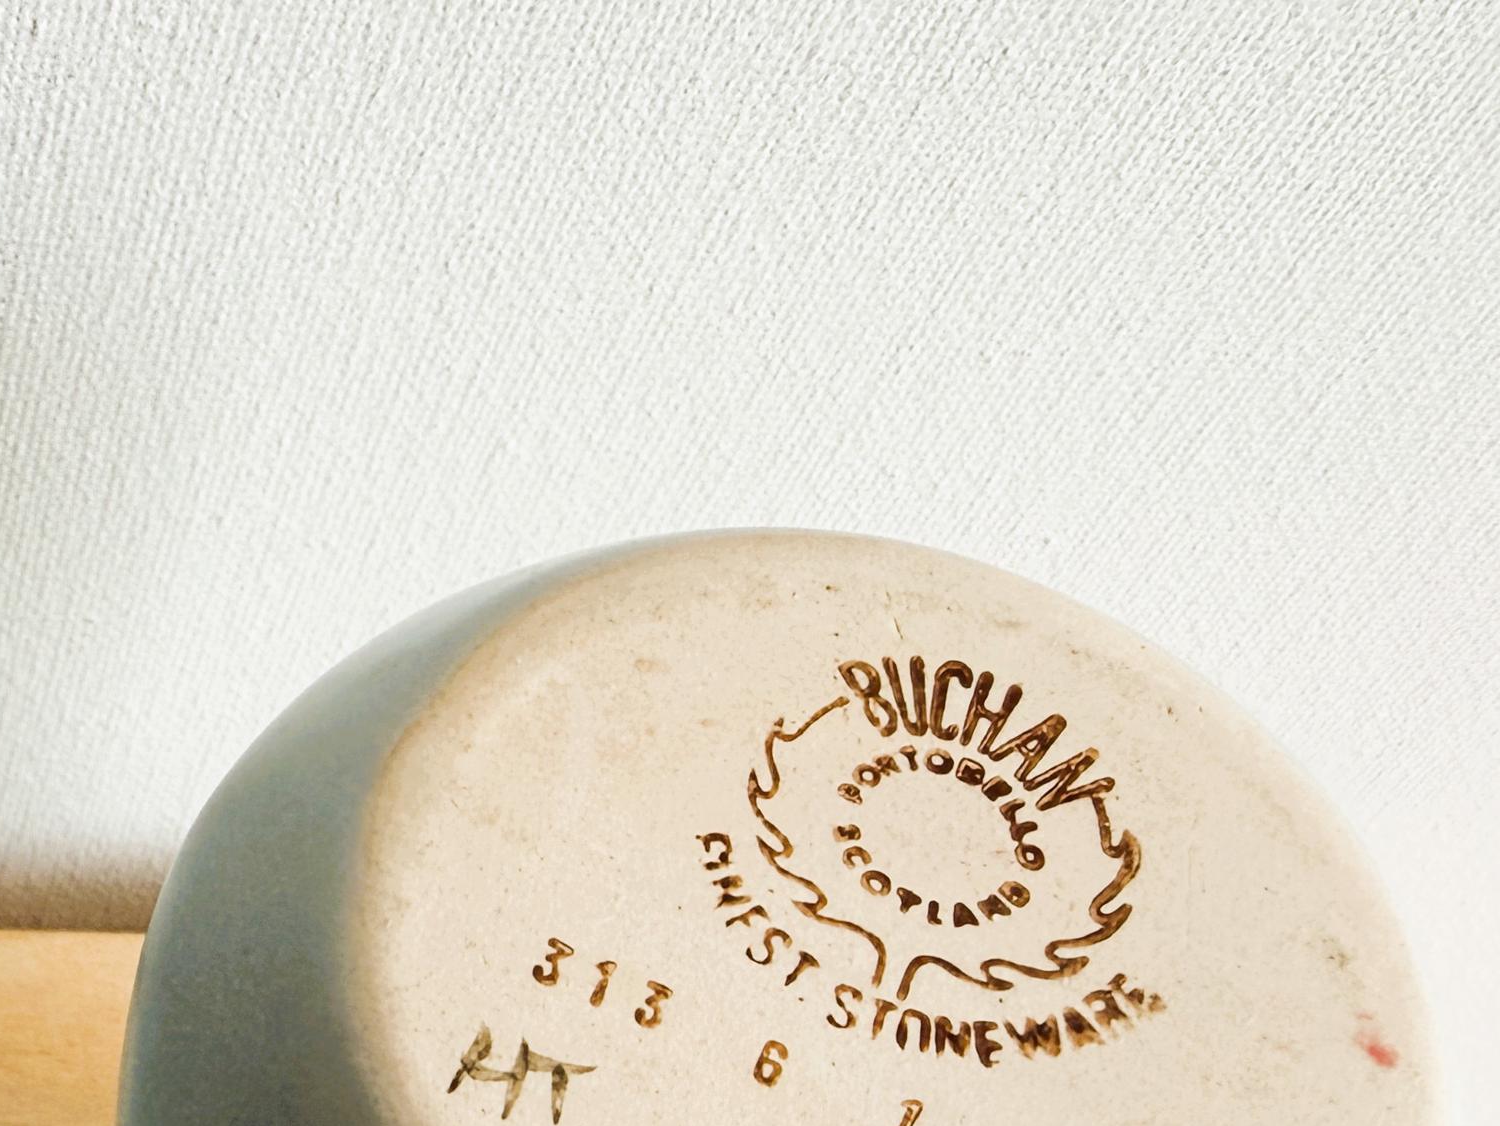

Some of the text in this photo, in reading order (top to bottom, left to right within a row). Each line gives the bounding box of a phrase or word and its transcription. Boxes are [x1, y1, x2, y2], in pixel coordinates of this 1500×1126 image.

[838, 655, 1116, 812] BUCHAN
[832, 823, 1032, 928] SCOTLAND
[532, 937, 674, 1029] 313
[752, 1039, 790, 1088] 6
